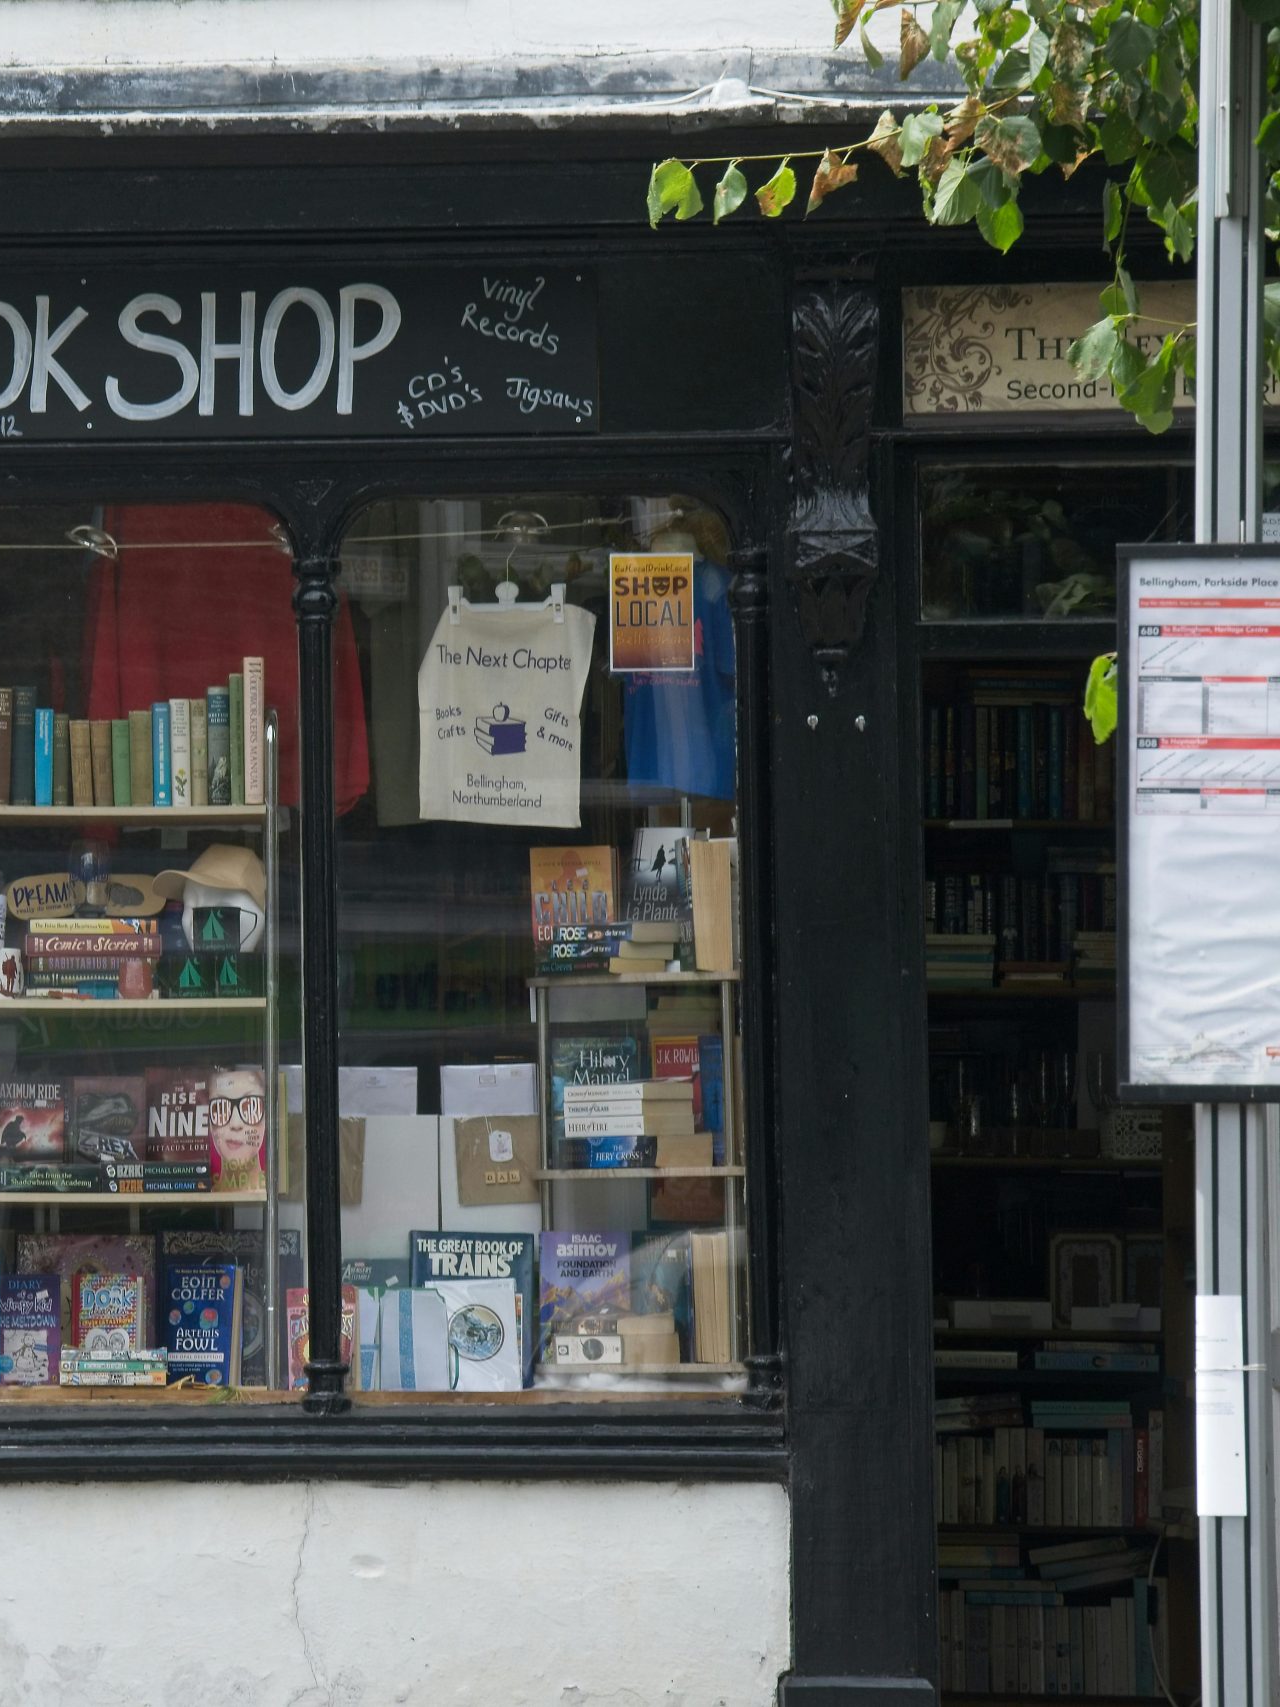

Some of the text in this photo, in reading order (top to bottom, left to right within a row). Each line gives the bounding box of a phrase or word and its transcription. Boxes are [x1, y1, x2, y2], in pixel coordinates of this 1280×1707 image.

[482, 276, 546, 322] Vinyl
[461, 303, 560, 354] Records
[105, 283, 402, 421] SHOP
[408, 356, 463, 399] CD's
[418, 384, 483, 419] DVD's
[505, 377, 594, 416] Jigsaws
[615, 576, 689, 597] SHOP
[1204, 578, 1248, 587] Parkside
[1251, 577, 1279, 587] Place
[616, 601, 689, 627] LOCAL
[1141, 627, 1159, 636] 680
[436, 644, 462, 666] The
[466, 646, 508, 668] Next
[436, 705, 462, 721] Books
[544, 707, 569, 728] Gifts
[437, 725, 466, 740] Crafts
[536, 727, 573, 751] & more
[1138, 739, 1158, 748] 808
[466, 774, 527, 792] Bellingham,
[452, 790, 543, 809] Northumberland
[633, 883, 668, 907] Lynda
[626, 903, 640, 921] La
[559, 927, 587, 941] ROSE
[45, 937, 139, 952] Comic Stories
[552, 944, 578, 958] ROSE
[580, 1050, 630, 1069] Hilry
[573, 1068, 630, 1085] Mantel
[38, 1084, 61, 1100] RIDE
[161, 1092, 197, 1105] RISE
[209, 1098, 232, 1127] GEEK
[148, 1105, 209, 1138] NINE
[147, 1144, 186, 1152] PITTACUS
[595, 1152, 640, 1161] FIERY CROSS
[61, 1171, 72, 1179] the
[145, 1165, 194, 1174] MICHAEL GRANT
[60, 1178, 92, 1188] Academy
[417, 1239, 523, 1255] THE GREAT BOOK OF
[571, 1234, 602, 1244] ISAAC
[556, 1243, 617, 1257] asimov
[429, 1252, 513, 1278] TRAINS
[557, 1260, 617, 1269] FOUNDATION
[560, 1269, 614, 1278] AND EARTH
[8, 1280, 43, 1290] DIARY
[82, 1287, 134, 1310] DORK
[171, 1288, 225, 1301] COLFER
[0, 1298, 53, 1314] Wimpy Kid
[11, 1316, 56, 1328] MELTDOWN
[175, 1338, 218, 1351] FOWL
